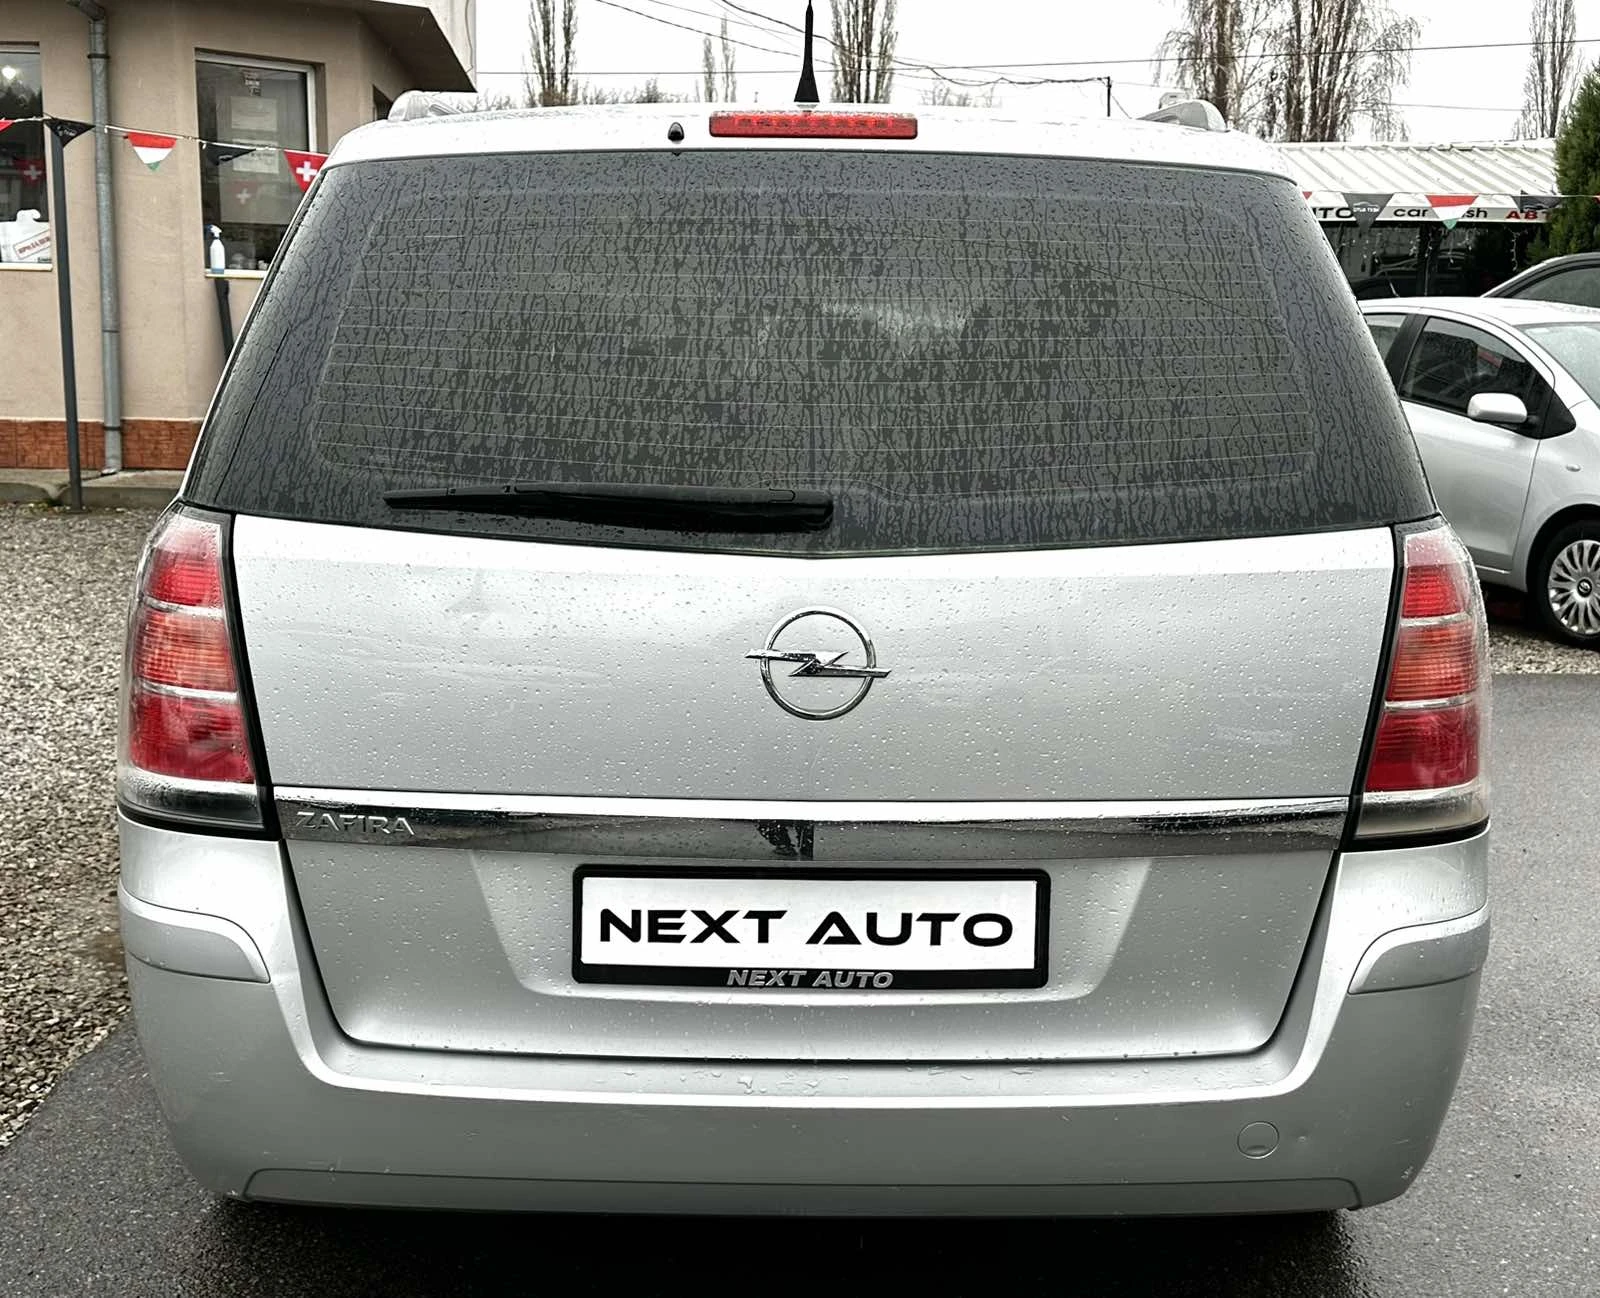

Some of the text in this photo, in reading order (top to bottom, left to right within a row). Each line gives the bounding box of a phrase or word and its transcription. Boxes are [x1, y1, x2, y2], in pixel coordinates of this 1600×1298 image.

[1313, 207, 1354, 219] TO
[1393, 208, 1429, 217] car
[295, 811, 415, 836] ZAFIRA
[600, 908, 1013, 947] NEXT AUTO
[727, 970, 893, 988] NEXT AUTO
